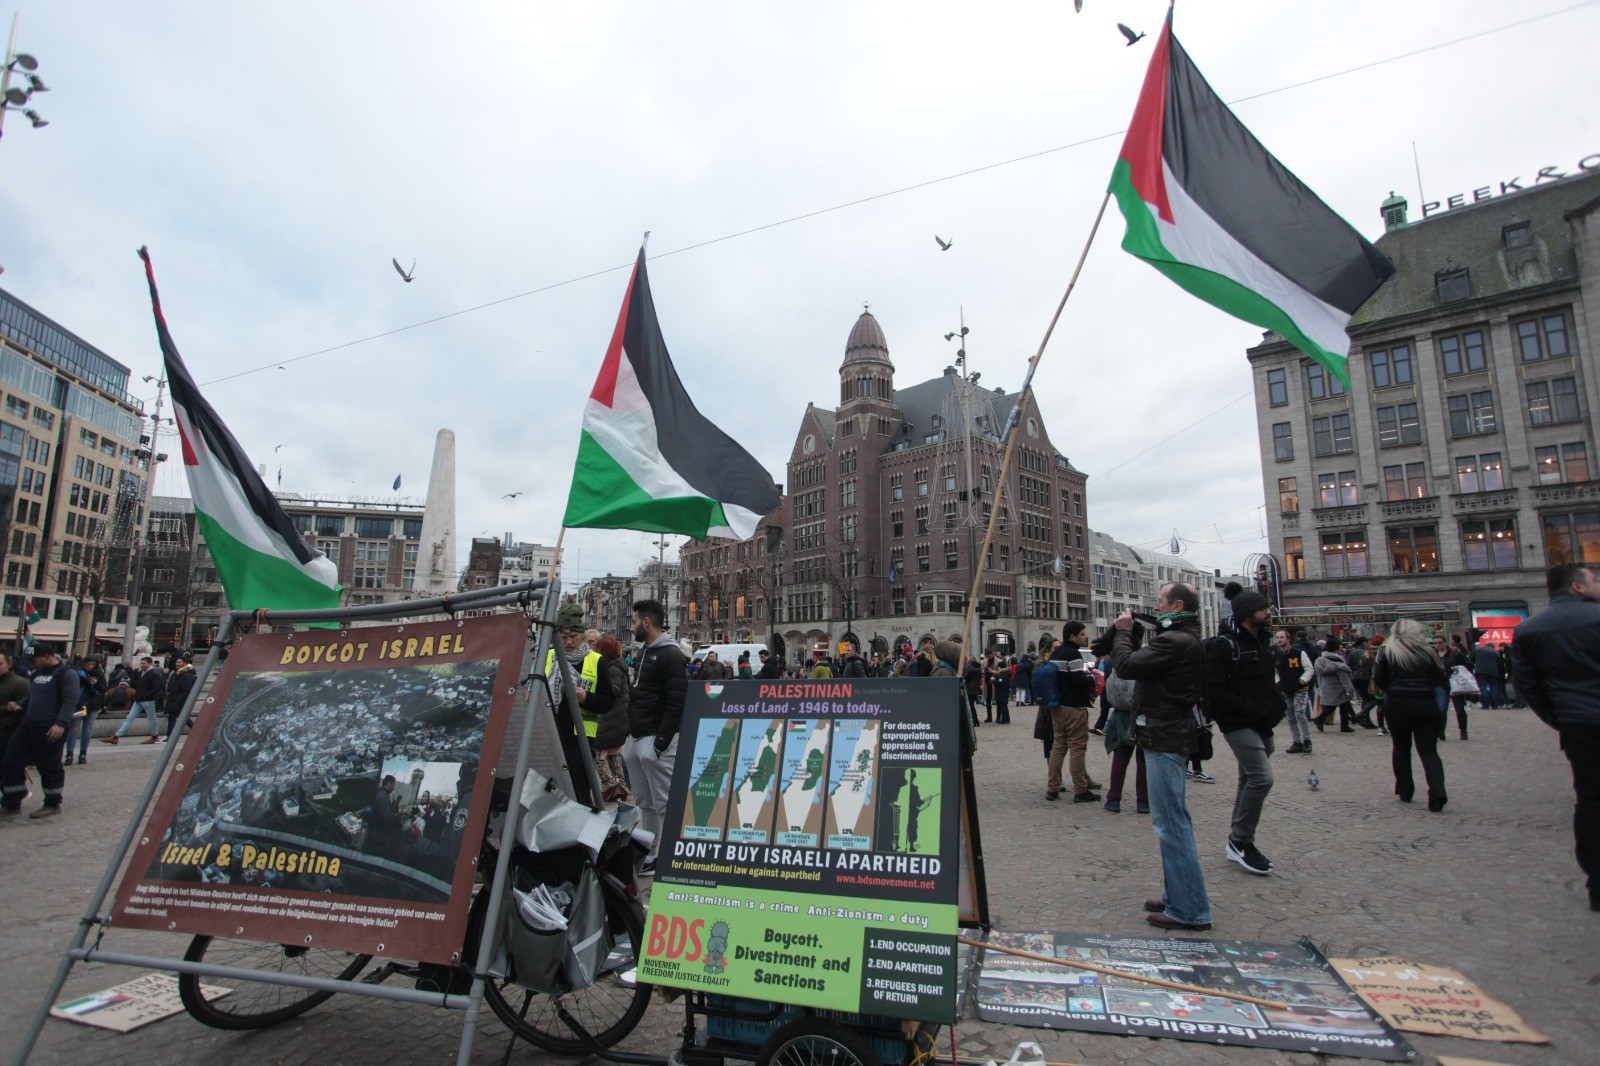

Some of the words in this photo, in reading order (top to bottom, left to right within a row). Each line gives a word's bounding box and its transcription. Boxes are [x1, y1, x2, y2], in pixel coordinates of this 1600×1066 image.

[305, 492, 341, 502] HOTEL
[1481, 630, 1510, 639] SAL
[279, 643, 370, 665] BOYCOT
[378, 633, 466, 661] ISRAEL
[1288, 656, 1300, 668] M
[759, 684, 852, 699] PALESTINIAN
[721, 702, 746, 713] Loss
[747, 702, 760, 713] of
[761, 702, 788, 714] Land
[798, 702, 829, 714] 1946
[831, 703, 844, 714] to
[883, 721, 896, 730] For
[897, 721, 931, 731] decades
[882, 731, 940, 743] expropriations
[882, 741, 924, 752] oppression
[926, 741, 935, 751] &
[881, 751, 938, 761] discrimination
[695, 789, 716, 798] Britain
[698, 781, 715, 789] Great
[160, 842, 212, 866] Israel
[216, 843, 232, 867] &
[241, 845, 341, 877] Palestina
[674, 841, 722, 860] DON'T
[725, 845, 760, 862] BUY
[763, 848, 831, 868] ISRAELI
[836, 853, 941, 875] APARTHEID
[671, 859, 682, 869] for
[683, 860, 732, 874] international
[733, 865, 748, 875] law
[748, 866, 779, 878] against
[780, 869, 821, 881] apartheid
[836, 874, 935, 890] www.bdsmovement.net
[190, 888, 232, 899] Midden-Oosten
[394, 907, 415, 917] gebied
[425, 911, 446, 921] andere
[667, 891, 741, 908] Anti-Semitism
[745, 899, 755, 909] is
[759, 902, 765, 910] a
[770, 902, 800, 913] crime
[807, 905, 883, 921] Anti-Zionism
[888, 914, 895, 922] a
[900, 912, 929, 929] duty
[647, 913, 706, 963] BDS
[869, 938, 894, 951] 1.END
[896, 941, 951, 956] OCCUPATION
[643, 959, 681, 971] MOVEMENT
[734, 945, 817, 969] Divestment
[821, 957, 851, 973] and
[867, 958, 893, 970] 2.END
[894, 961, 943, 975] APARTHEID
[642, 966, 674, 979] FREEDOM
[674, 971, 701, 982] JUSTICE
[703, 975, 731, 987] EQALITY
[753, 968, 826, 992] Sanctions
[866, 977, 917, 993] 3.REFUGEES
[918, 983, 944, 996] RIGHT
[873, 989, 886, 1000] OF
[886, 990, 918, 1004] RETURN
[978, 1003, 1106, 1021] staatsterrorisme
[1390, 1012, 1521, 1035] Nederland
[1257, 1028, 1395, 1048] Meedogenloos
